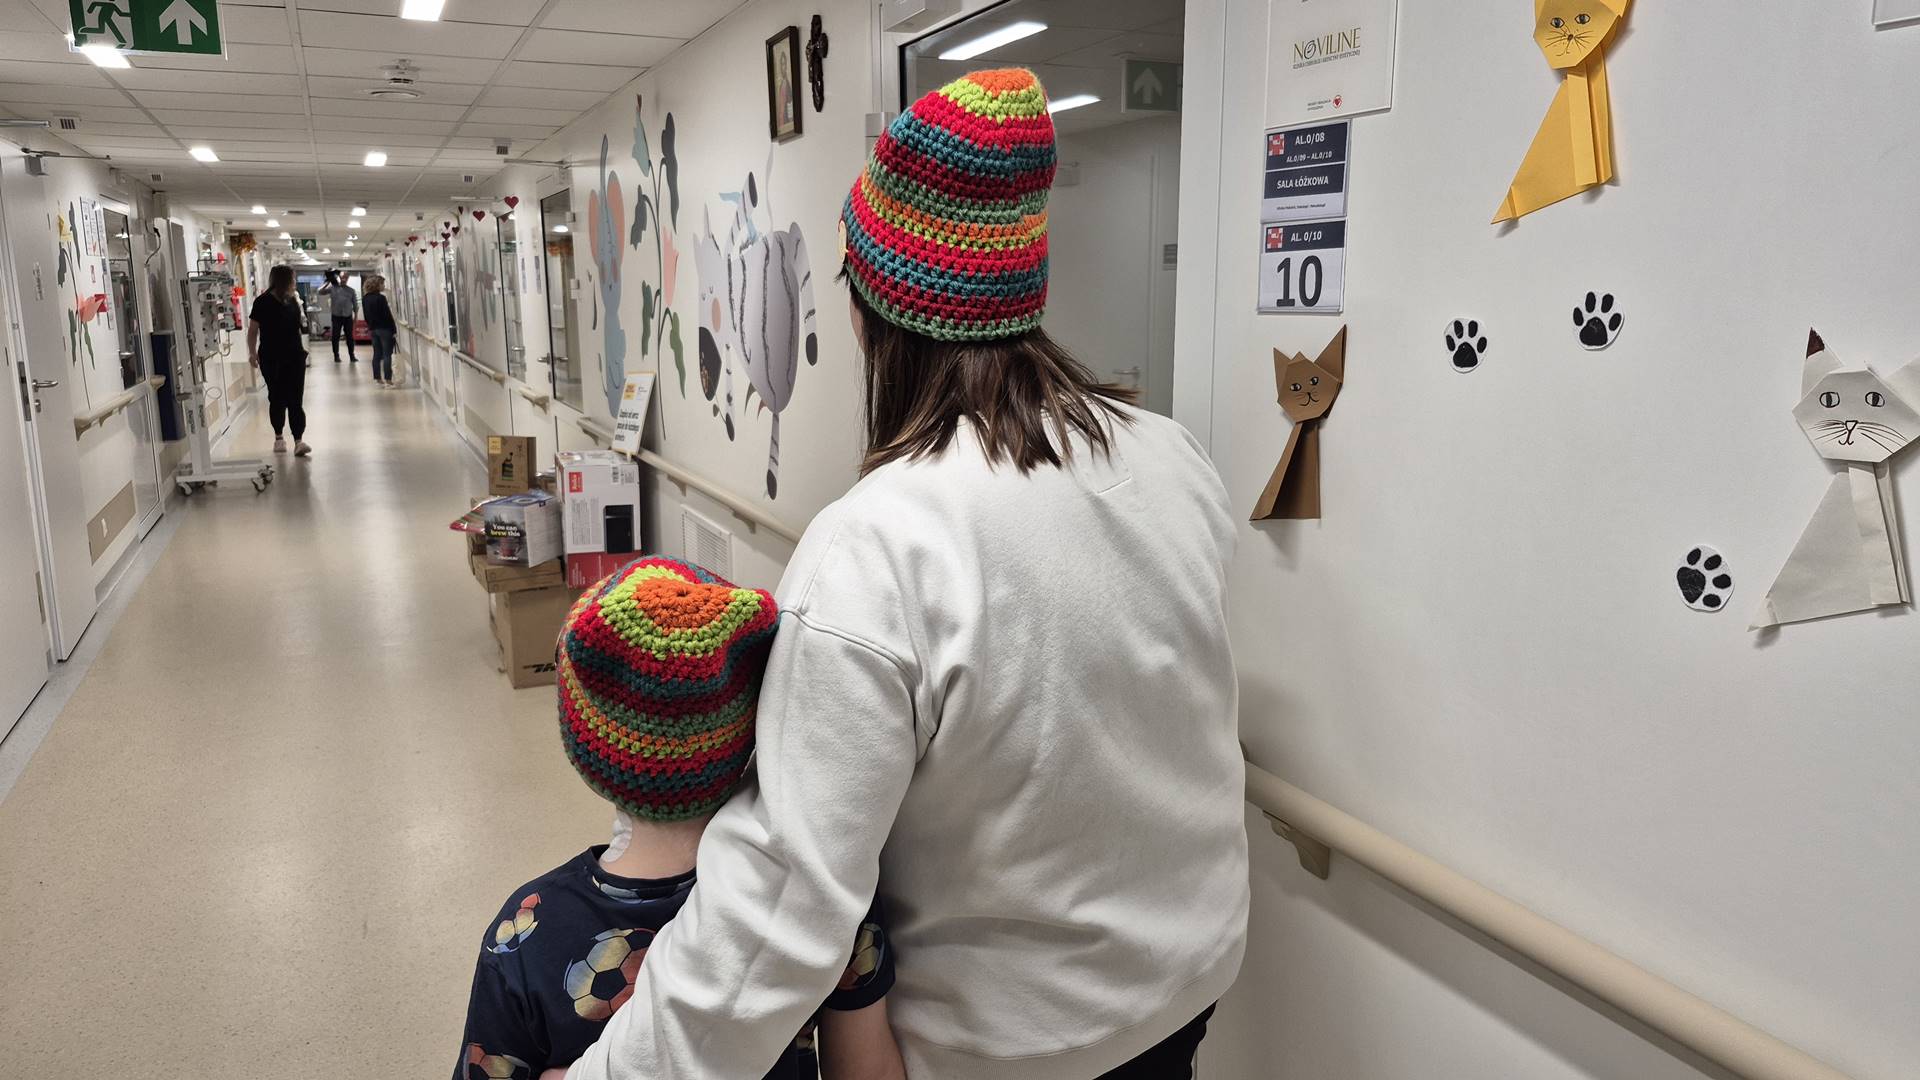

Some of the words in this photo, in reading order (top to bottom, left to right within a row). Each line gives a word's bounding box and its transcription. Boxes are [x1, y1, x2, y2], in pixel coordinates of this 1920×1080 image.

[1293, 27, 1361, 64] NOVILINE
[1295, 132, 1325, 146] AL.0/08
[1276, 180, 1294, 189] SALA
[1294, 175, 1329, 188] ŁÓŻKOWA
[1303, 231, 1322, 242] 0/10
[1276, 255, 1323, 307] 10
[492, 523, 505, 531] You
